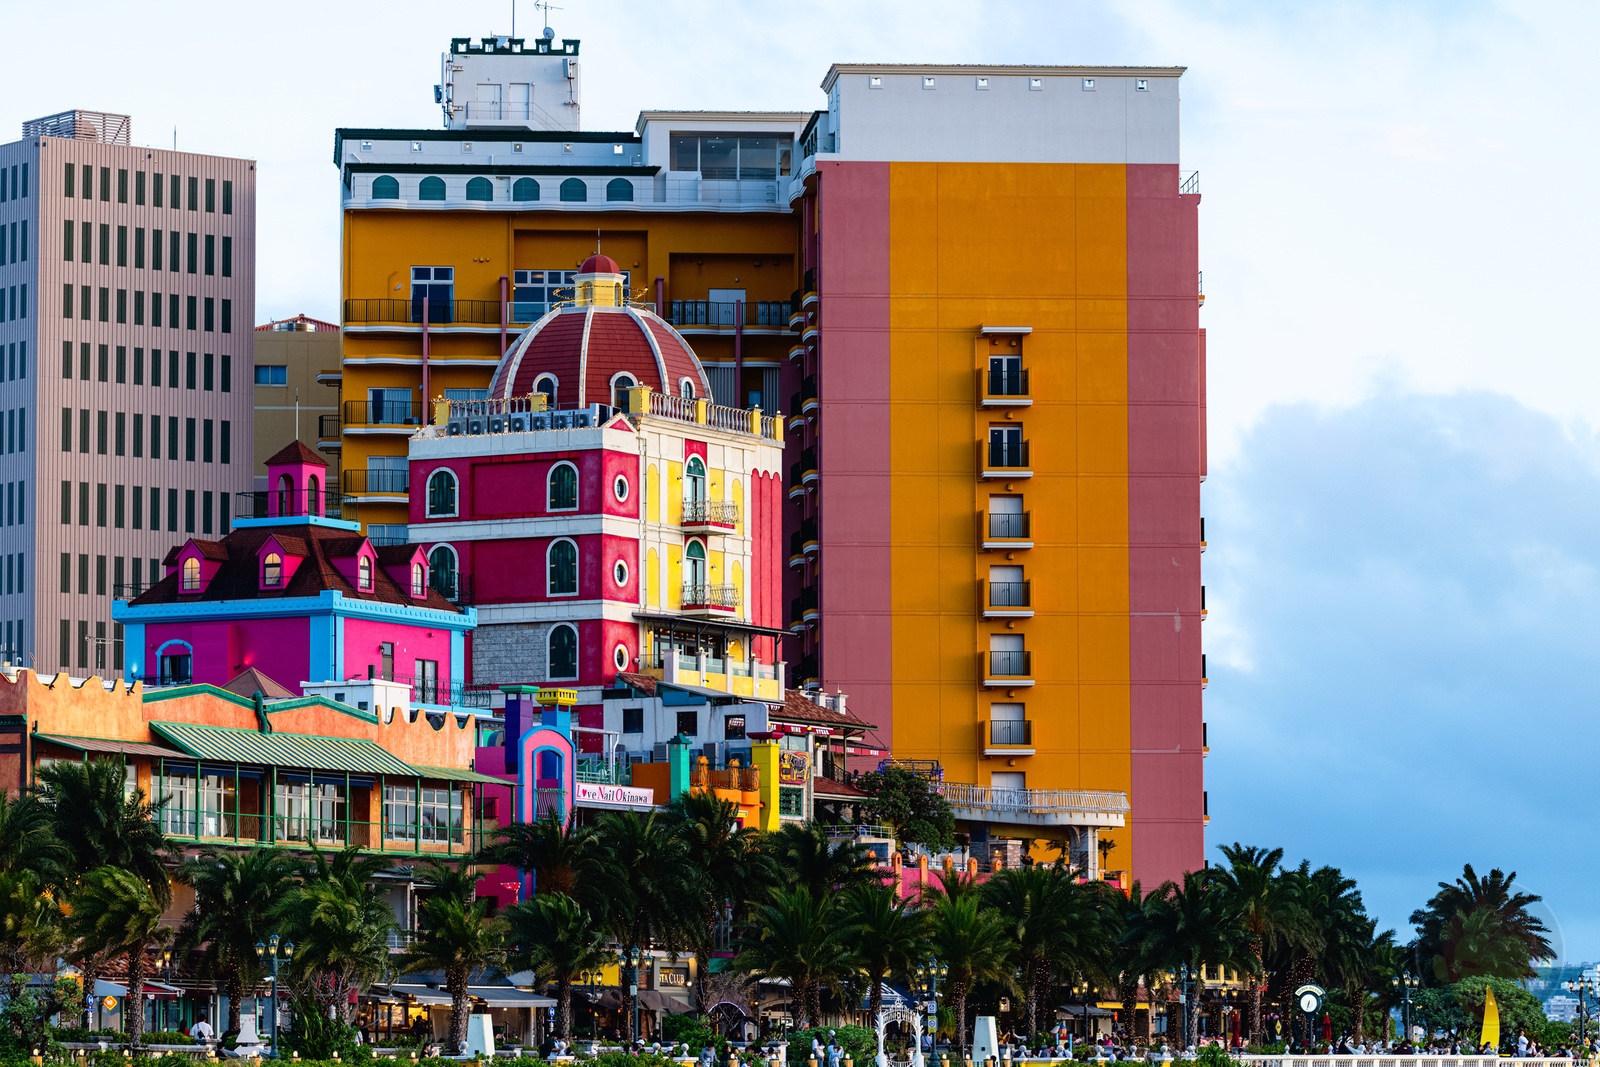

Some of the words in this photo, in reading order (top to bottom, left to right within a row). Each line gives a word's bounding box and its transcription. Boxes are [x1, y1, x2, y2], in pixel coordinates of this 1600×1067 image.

[598, 786, 615, 801] Nail
[615, 787, 648, 803] Okinawa
[669, 972, 685, 985] CLUB
